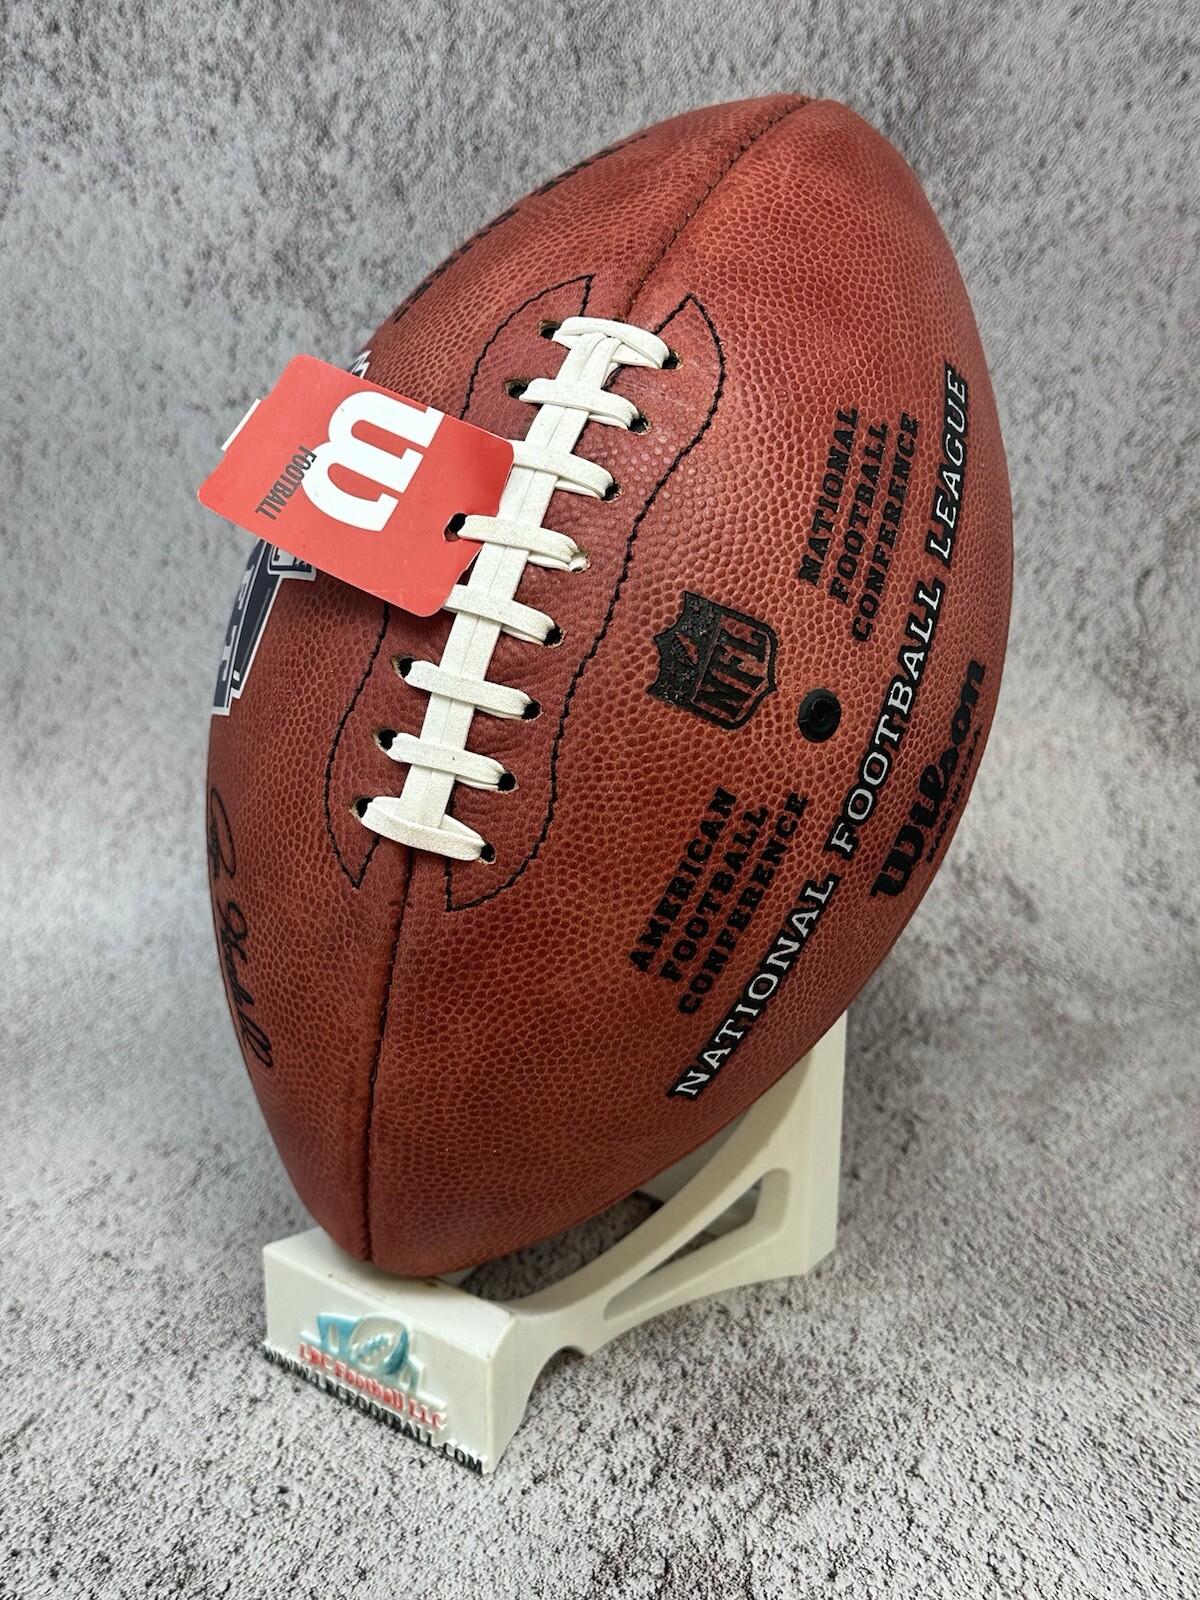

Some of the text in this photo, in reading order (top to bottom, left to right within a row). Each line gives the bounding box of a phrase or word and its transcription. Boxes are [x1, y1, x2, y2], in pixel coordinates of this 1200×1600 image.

[255, 445, 317, 520] FOOTBALL
[799, 407, 859, 587] NATIONAL
[829, 420, 889, 604] FOOTBALL
[852, 412, 919, 641] CONFERENCE
[668, 361, 969, 1099] NATIONAL FOOTBALL LEAGUE
[694, 628, 768, 718] NFL
[871, 659, 985, 898] Wilson
[926, 807, 953, 863] MADE
[950, 784, 962, 804] IN
[629, 787, 737, 973] AMERICAN
[659, 804, 769, 983] FOOTBALL
[678, 791, 809, 1015] CONFERENCE
[408, 1398, 447, 1432] LLC
